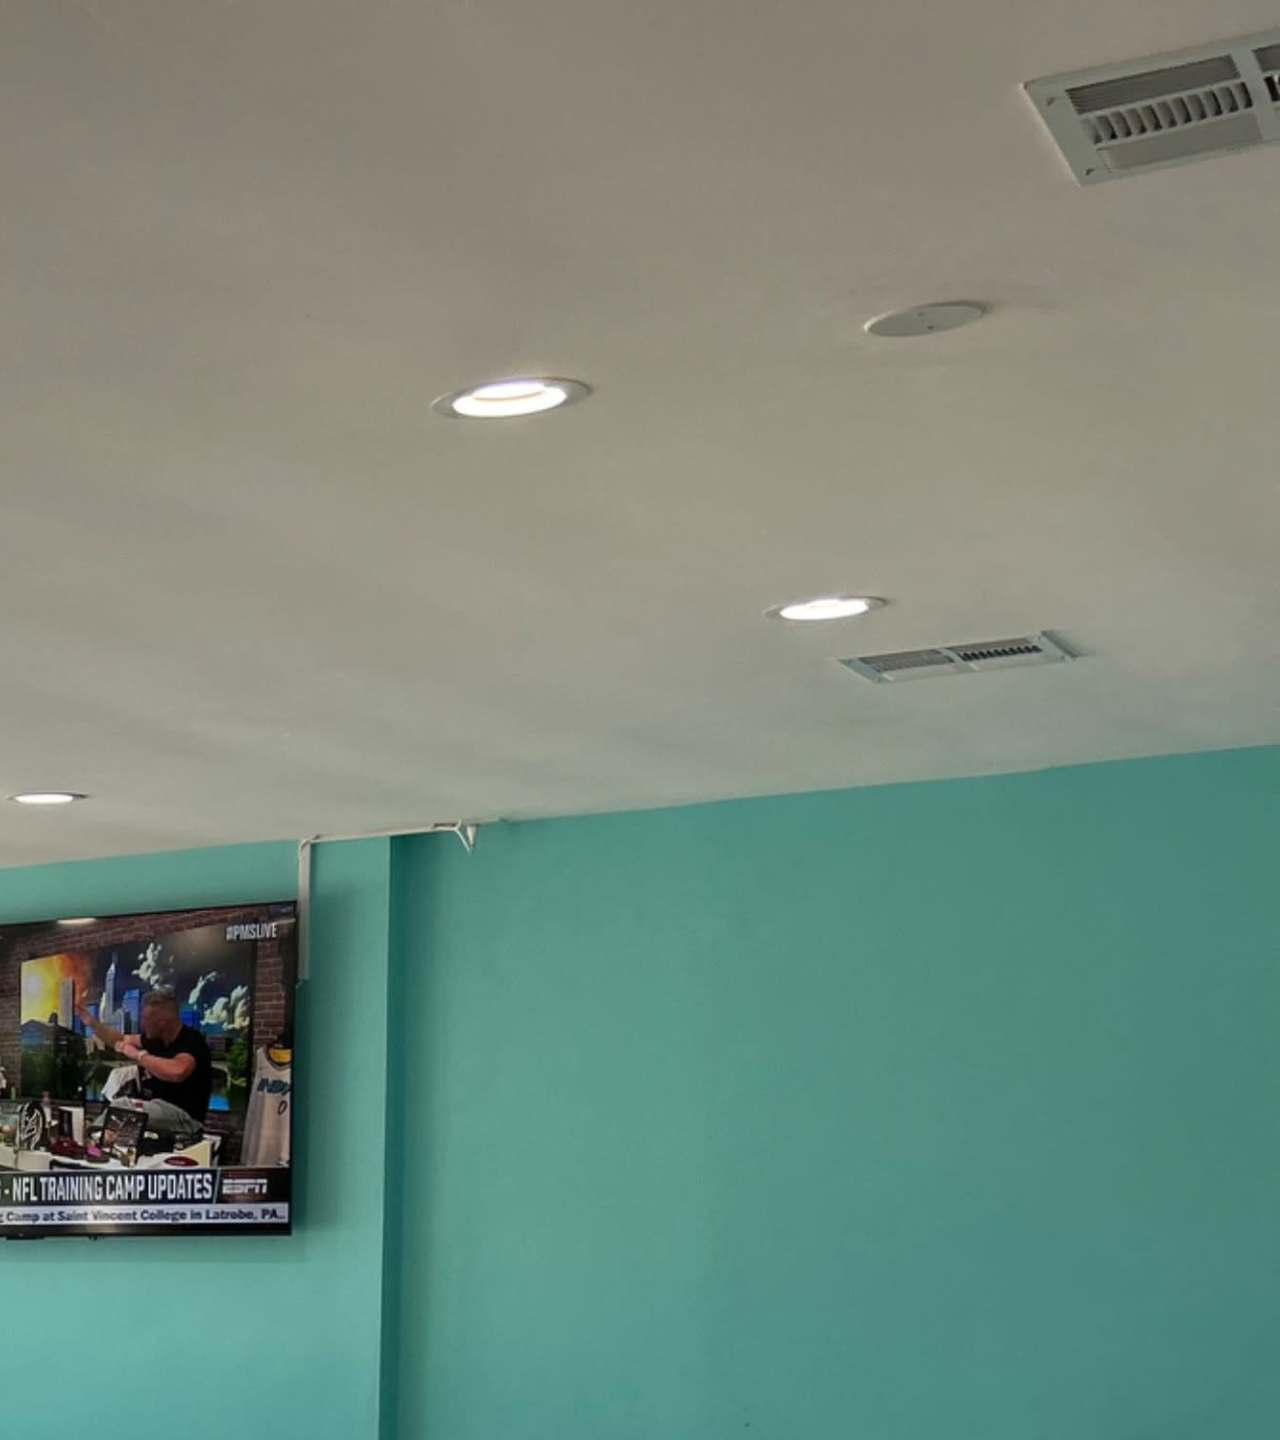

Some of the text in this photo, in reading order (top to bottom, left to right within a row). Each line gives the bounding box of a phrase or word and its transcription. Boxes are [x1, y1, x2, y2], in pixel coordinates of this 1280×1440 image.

[13, 1176, 38, 1202] NFL
[40, 1175, 102, 1202] TRAINING
[106, 1174, 145, 1201] CAMP
[148, 1173, 213, 1200] UPDATES
[222, 1178, 268, 1195] ESPN
[6, 1211, 40, 1225] Camp
[43, 1211, 55, 1222] at
[57, 1210, 89, 1222] Saint
[92, 1209, 138, 1222] Vincent
[140, 1210, 188, 1225] College
[191, 1208, 203, 1220] in
